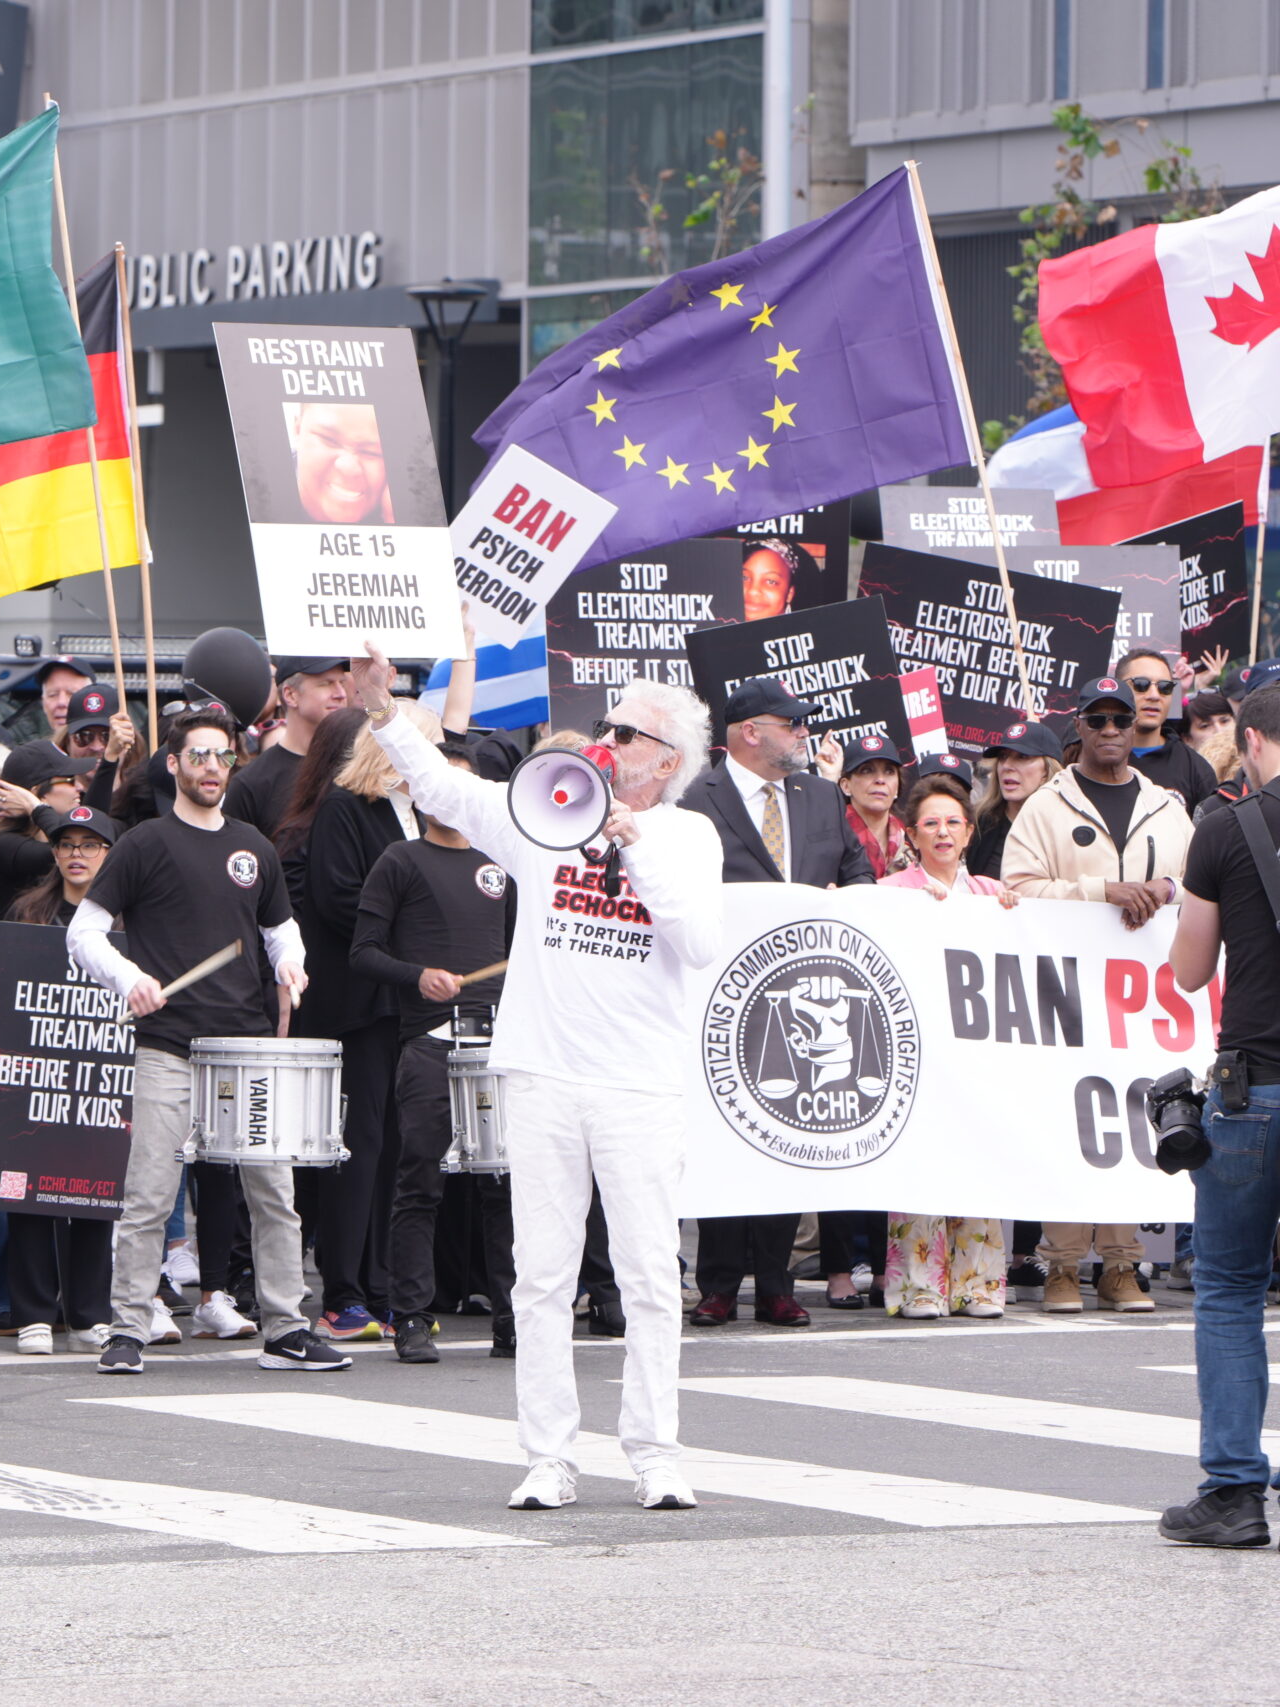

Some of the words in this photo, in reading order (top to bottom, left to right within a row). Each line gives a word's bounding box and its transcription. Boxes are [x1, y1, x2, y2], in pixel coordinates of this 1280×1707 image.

[226, 231, 378, 301] PARKING
[248, 337, 385, 368] RESTRAINT
[281, 368, 366, 397] DEATH
[492, 482, 578, 553] BAN
[319, 533, 363, 556] AGE
[368, 534, 396, 557] 15
[468, 526, 545, 584] PSYCH
[307, 572, 420, 598] JEREMIAH
[453, 556, 538, 625] OERCION
[620, 563, 668, 590] STOP
[1212, 570, 1226, 594] IT
[307, 603, 426, 630] FLEMMING
[577, 592, 716, 621] ELECTROSHOCK
[1137, 612, 1153, 637] IT
[763, 632, 815, 668] STOP
[572, 657, 639, 685] BEFORE
[644, 659, 661, 683] IT
[1058, 660, 1080, 689] IT
[960, 671, 1001, 704] OUR
[552, 888, 653, 925] SCHOCK
[544, 936, 562, 949] not
[569, 938, 651, 963] THERAPY
[574, 922, 654, 947] TORTURE
[839, 929, 862, 956] ON
[721, 925, 832, 1001] COMMISSION
[862, 946, 909, 1015] HUMAN
[944, 948, 1084, 1047] BAN
[707, 1003, 738, 1096] CITIZENS
[895, 1019, 916, 1095] RIGHTS
[75, 1061, 96, 1093] IT
[99, 1064, 135, 1096] STO
[28, 1091, 70, 1124] OUR
[76, 1096, 126, 1129] KIDS.
[249, 1077, 268, 1147] YAMAHA
[796, 1091, 860, 1122] CCHR
[768, 1134, 851, 1162] Established
[855, 1132, 880, 1158] 1969
[38, 1175, 117, 1197] CCHR.ORG/ECT
[99, 1199, 118, 1208] HUMAN
